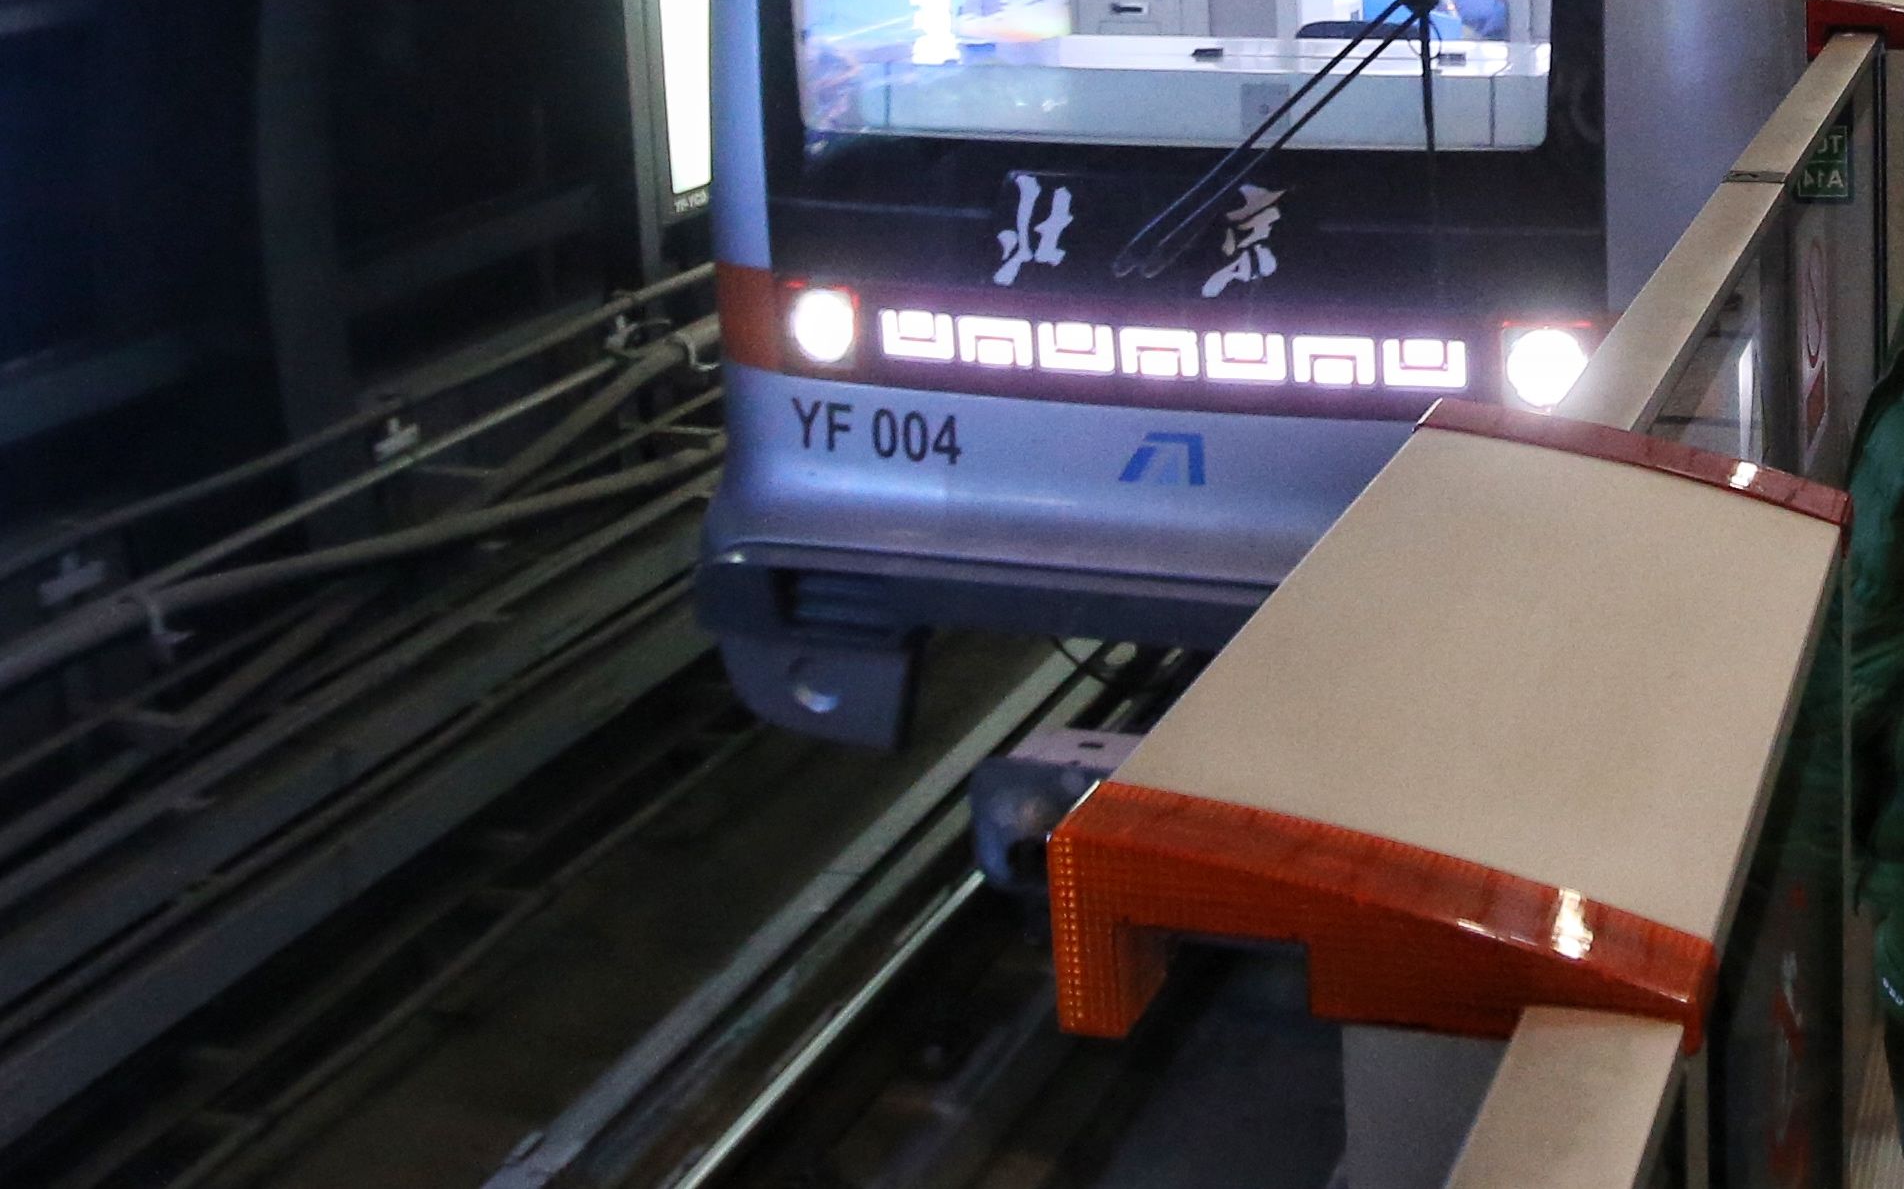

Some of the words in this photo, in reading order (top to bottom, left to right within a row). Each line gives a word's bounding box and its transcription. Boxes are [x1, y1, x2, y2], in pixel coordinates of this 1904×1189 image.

[994, 174, 1288, 298] 北京
[792, 396, 853, 452] YF
[871, 409, 962, 465] 004
